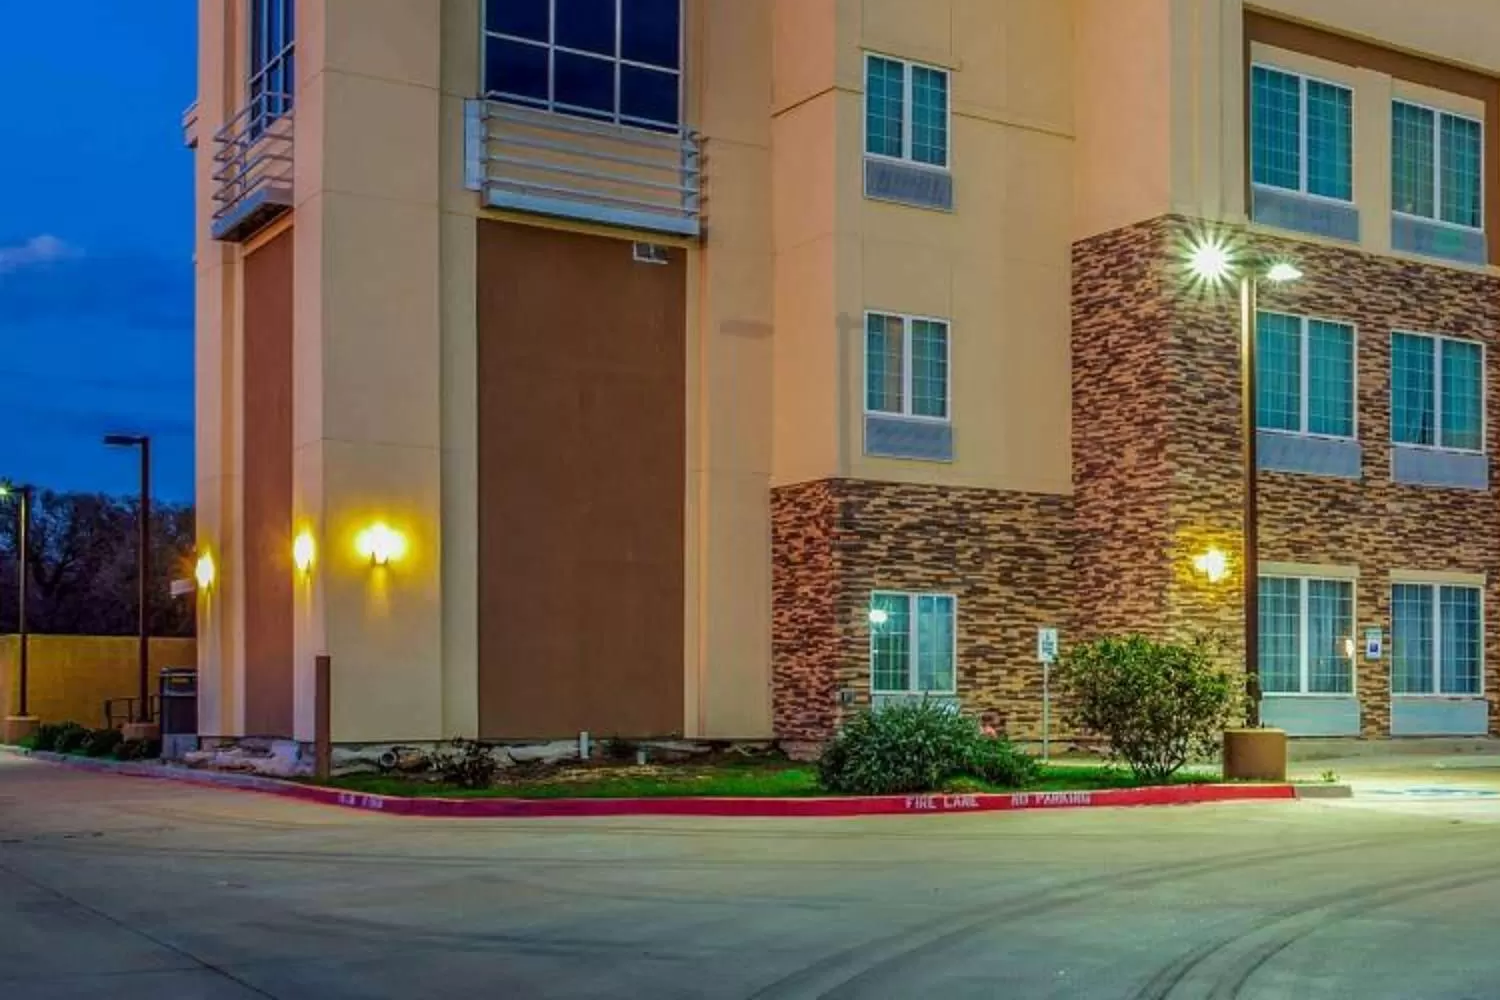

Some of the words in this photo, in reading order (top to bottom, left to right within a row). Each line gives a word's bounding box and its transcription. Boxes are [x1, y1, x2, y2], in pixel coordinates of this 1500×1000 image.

[905, 794, 938, 809] FIRE
[1011, 793, 1030, 807] NO
[1034, 791, 1091, 805] PARKING
